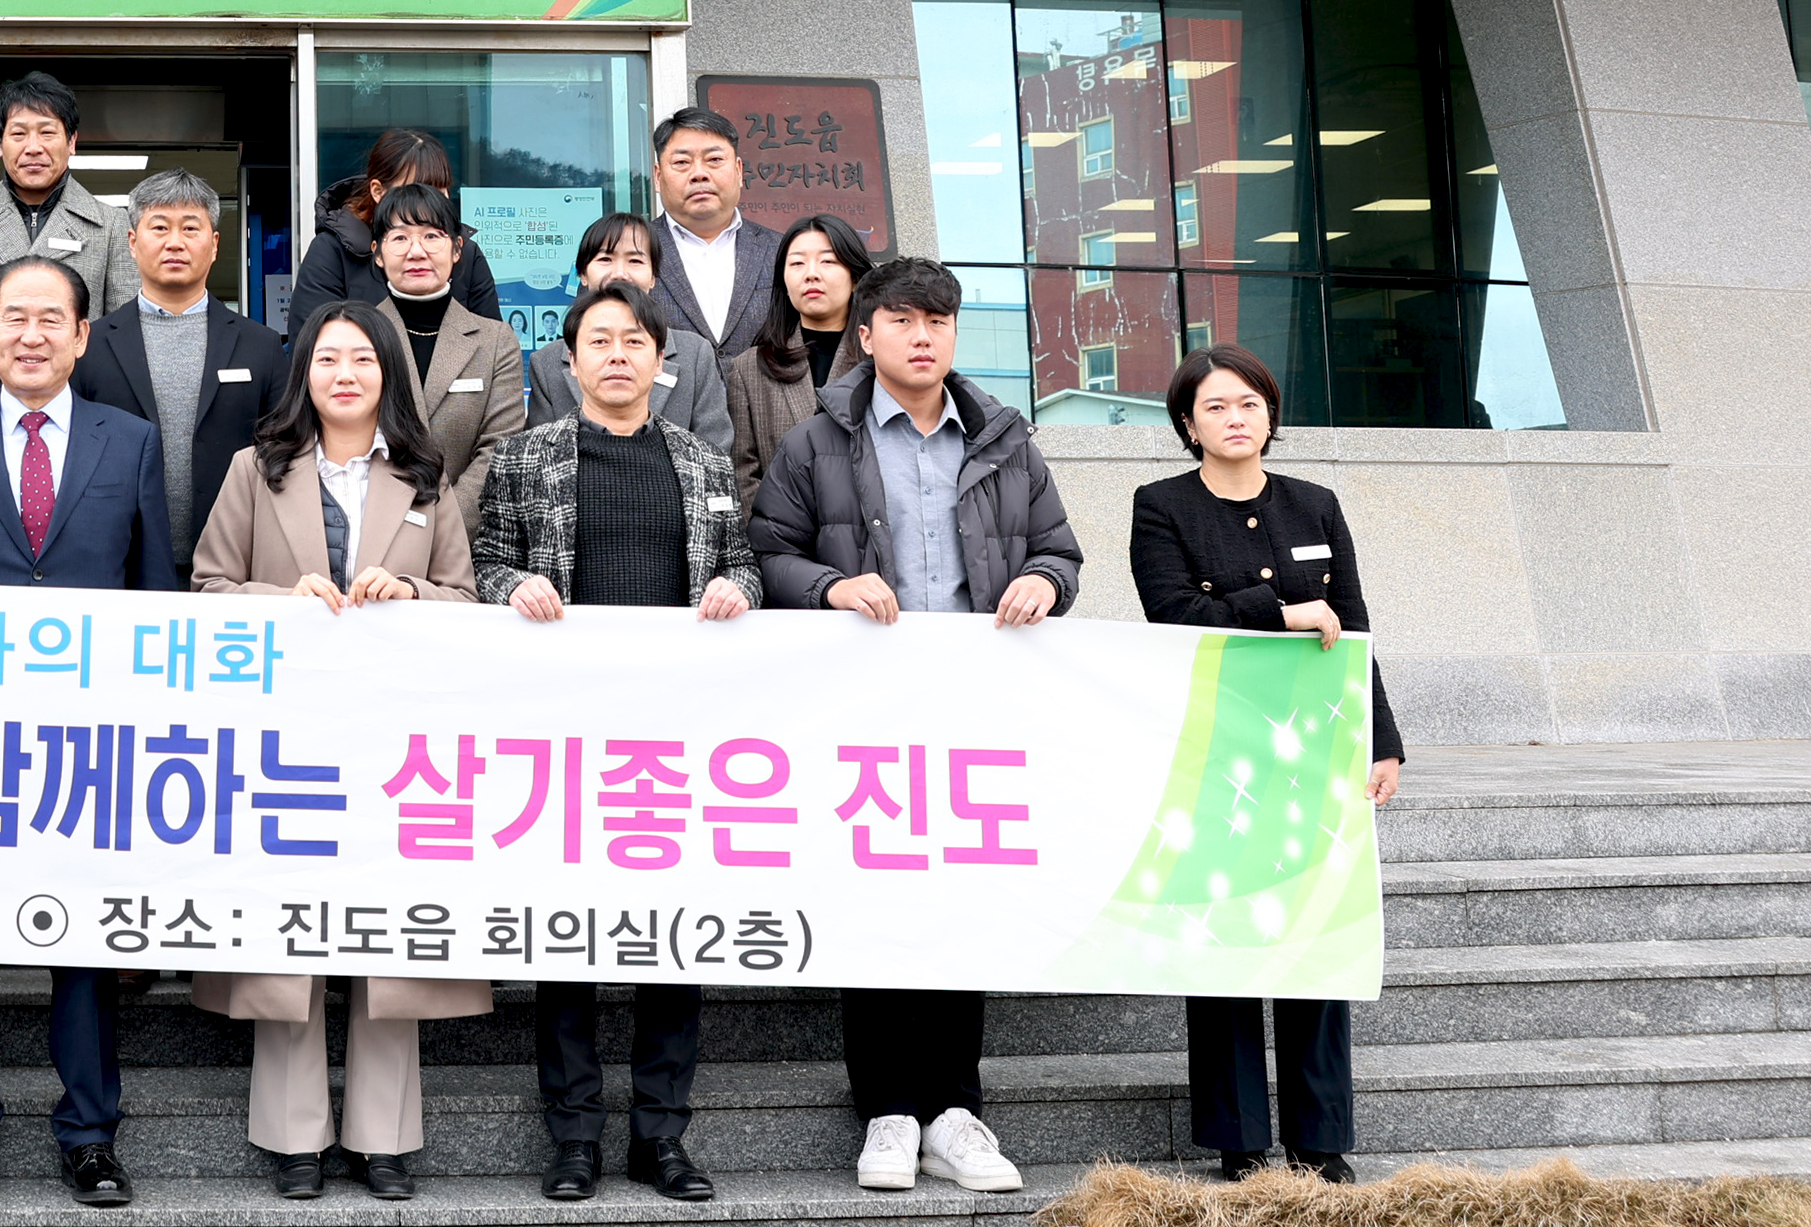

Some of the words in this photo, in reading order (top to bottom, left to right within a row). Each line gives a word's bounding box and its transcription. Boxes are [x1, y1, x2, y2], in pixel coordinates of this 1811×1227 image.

[746, 110, 843, 153] 진도읍
[474, 207, 485, 218] AI
[487, 207, 516, 218] 프로필
[518, 207, 548, 218] 사진은
[771, 202, 800, 214] 주인이
[826, 203, 867, 216] 자치실현
[507, 248, 516, 259] 수
[519, 248, 560, 260] 없습니다.
[515, 234, 574, 246] 주민등록증에
[131, 617, 285, 694] 대화
[380, 732, 799, 871] 살기좋은
[832, 743, 1039, 872] 진도
[97, 895, 244, 950] 장소:
[278, 901, 458, 962] 진도읍
[481, 905, 815, 973] 회의실(2층)
